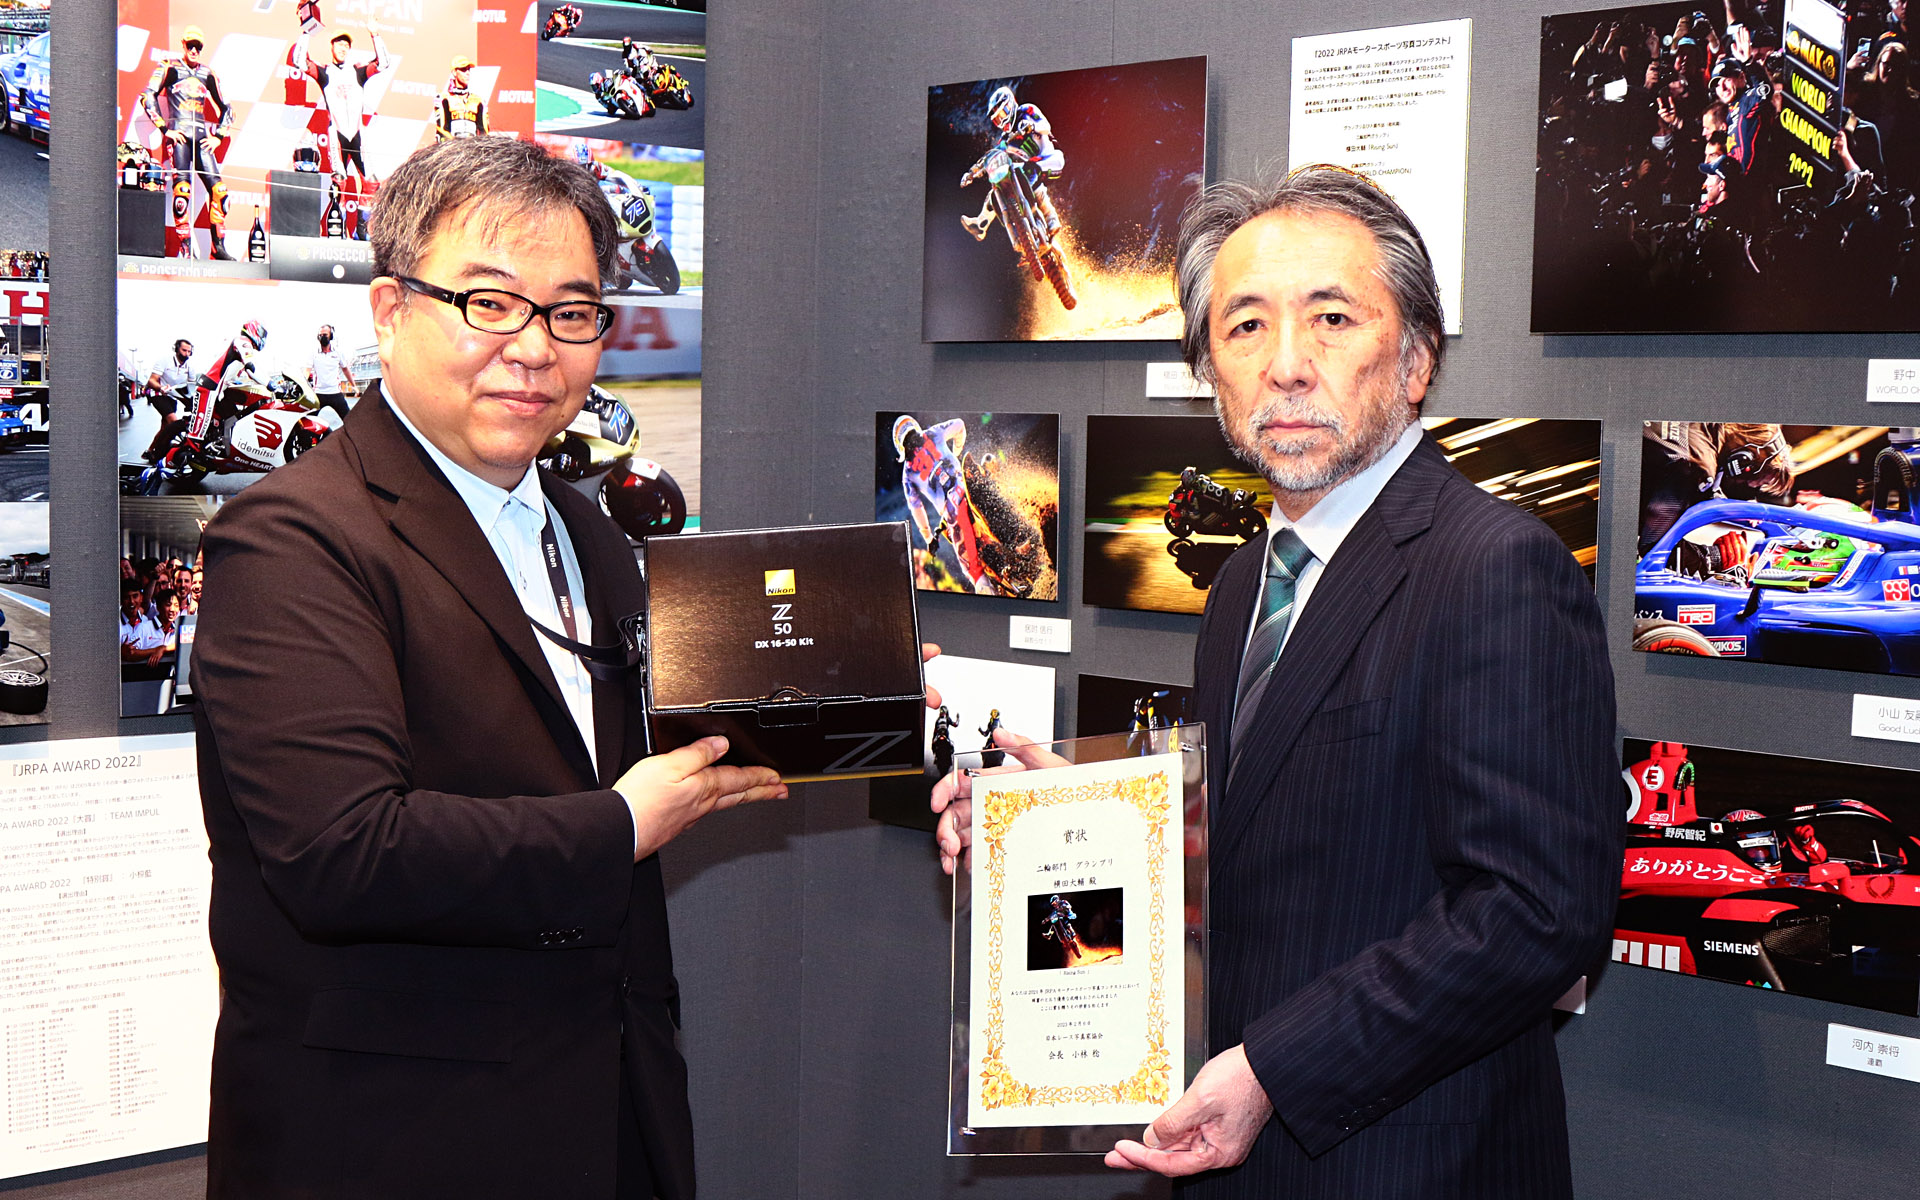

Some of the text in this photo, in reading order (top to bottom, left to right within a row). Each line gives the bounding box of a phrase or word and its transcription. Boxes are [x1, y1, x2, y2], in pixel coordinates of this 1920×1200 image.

[1800, 37, 1824, 72] MAX
[1791, 72, 1826, 114] WORLD
[1780, 107, 1832, 160] CHAMPION
[1894, 368, 1915, 381] 野中
[1876, 385, 1908, 394] WORLD
[237, 438, 276, 458] idemitsu
[546, 543, 557, 568] Nikon
[767, 587, 795, 595] Nikon
[559, 595, 571, 618] Nikon
[774, 622, 793, 635] 50
[755, 637, 814, 649] DX 16-50 Kit
[1878, 707, 1900, 719] 小山
[1878, 723, 1920, 735] Good Luc
[53, 758, 101, 774] AWARD
[11, 819, 45, 829] AWARD
[110, 811, 133, 820] TEAM
[134, 808, 160, 818] IMPUL
[1063, 828, 1087, 844] 賞状
[1664, 827, 1706, 842] 野尻智紀
[1036, 858, 1113, 872] 二輪部門 グランプリ
[14, 881, 47, 892] AWARD
[49, 878, 71, 889] 2022
[1703, 940, 1760, 956] SIEMENS
[1049, 1050, 1064, 1060] 会長
[1072, 1049, 1088, 1059] 小林
[1852, 1038, 1900, 1057] 河内 崇将
